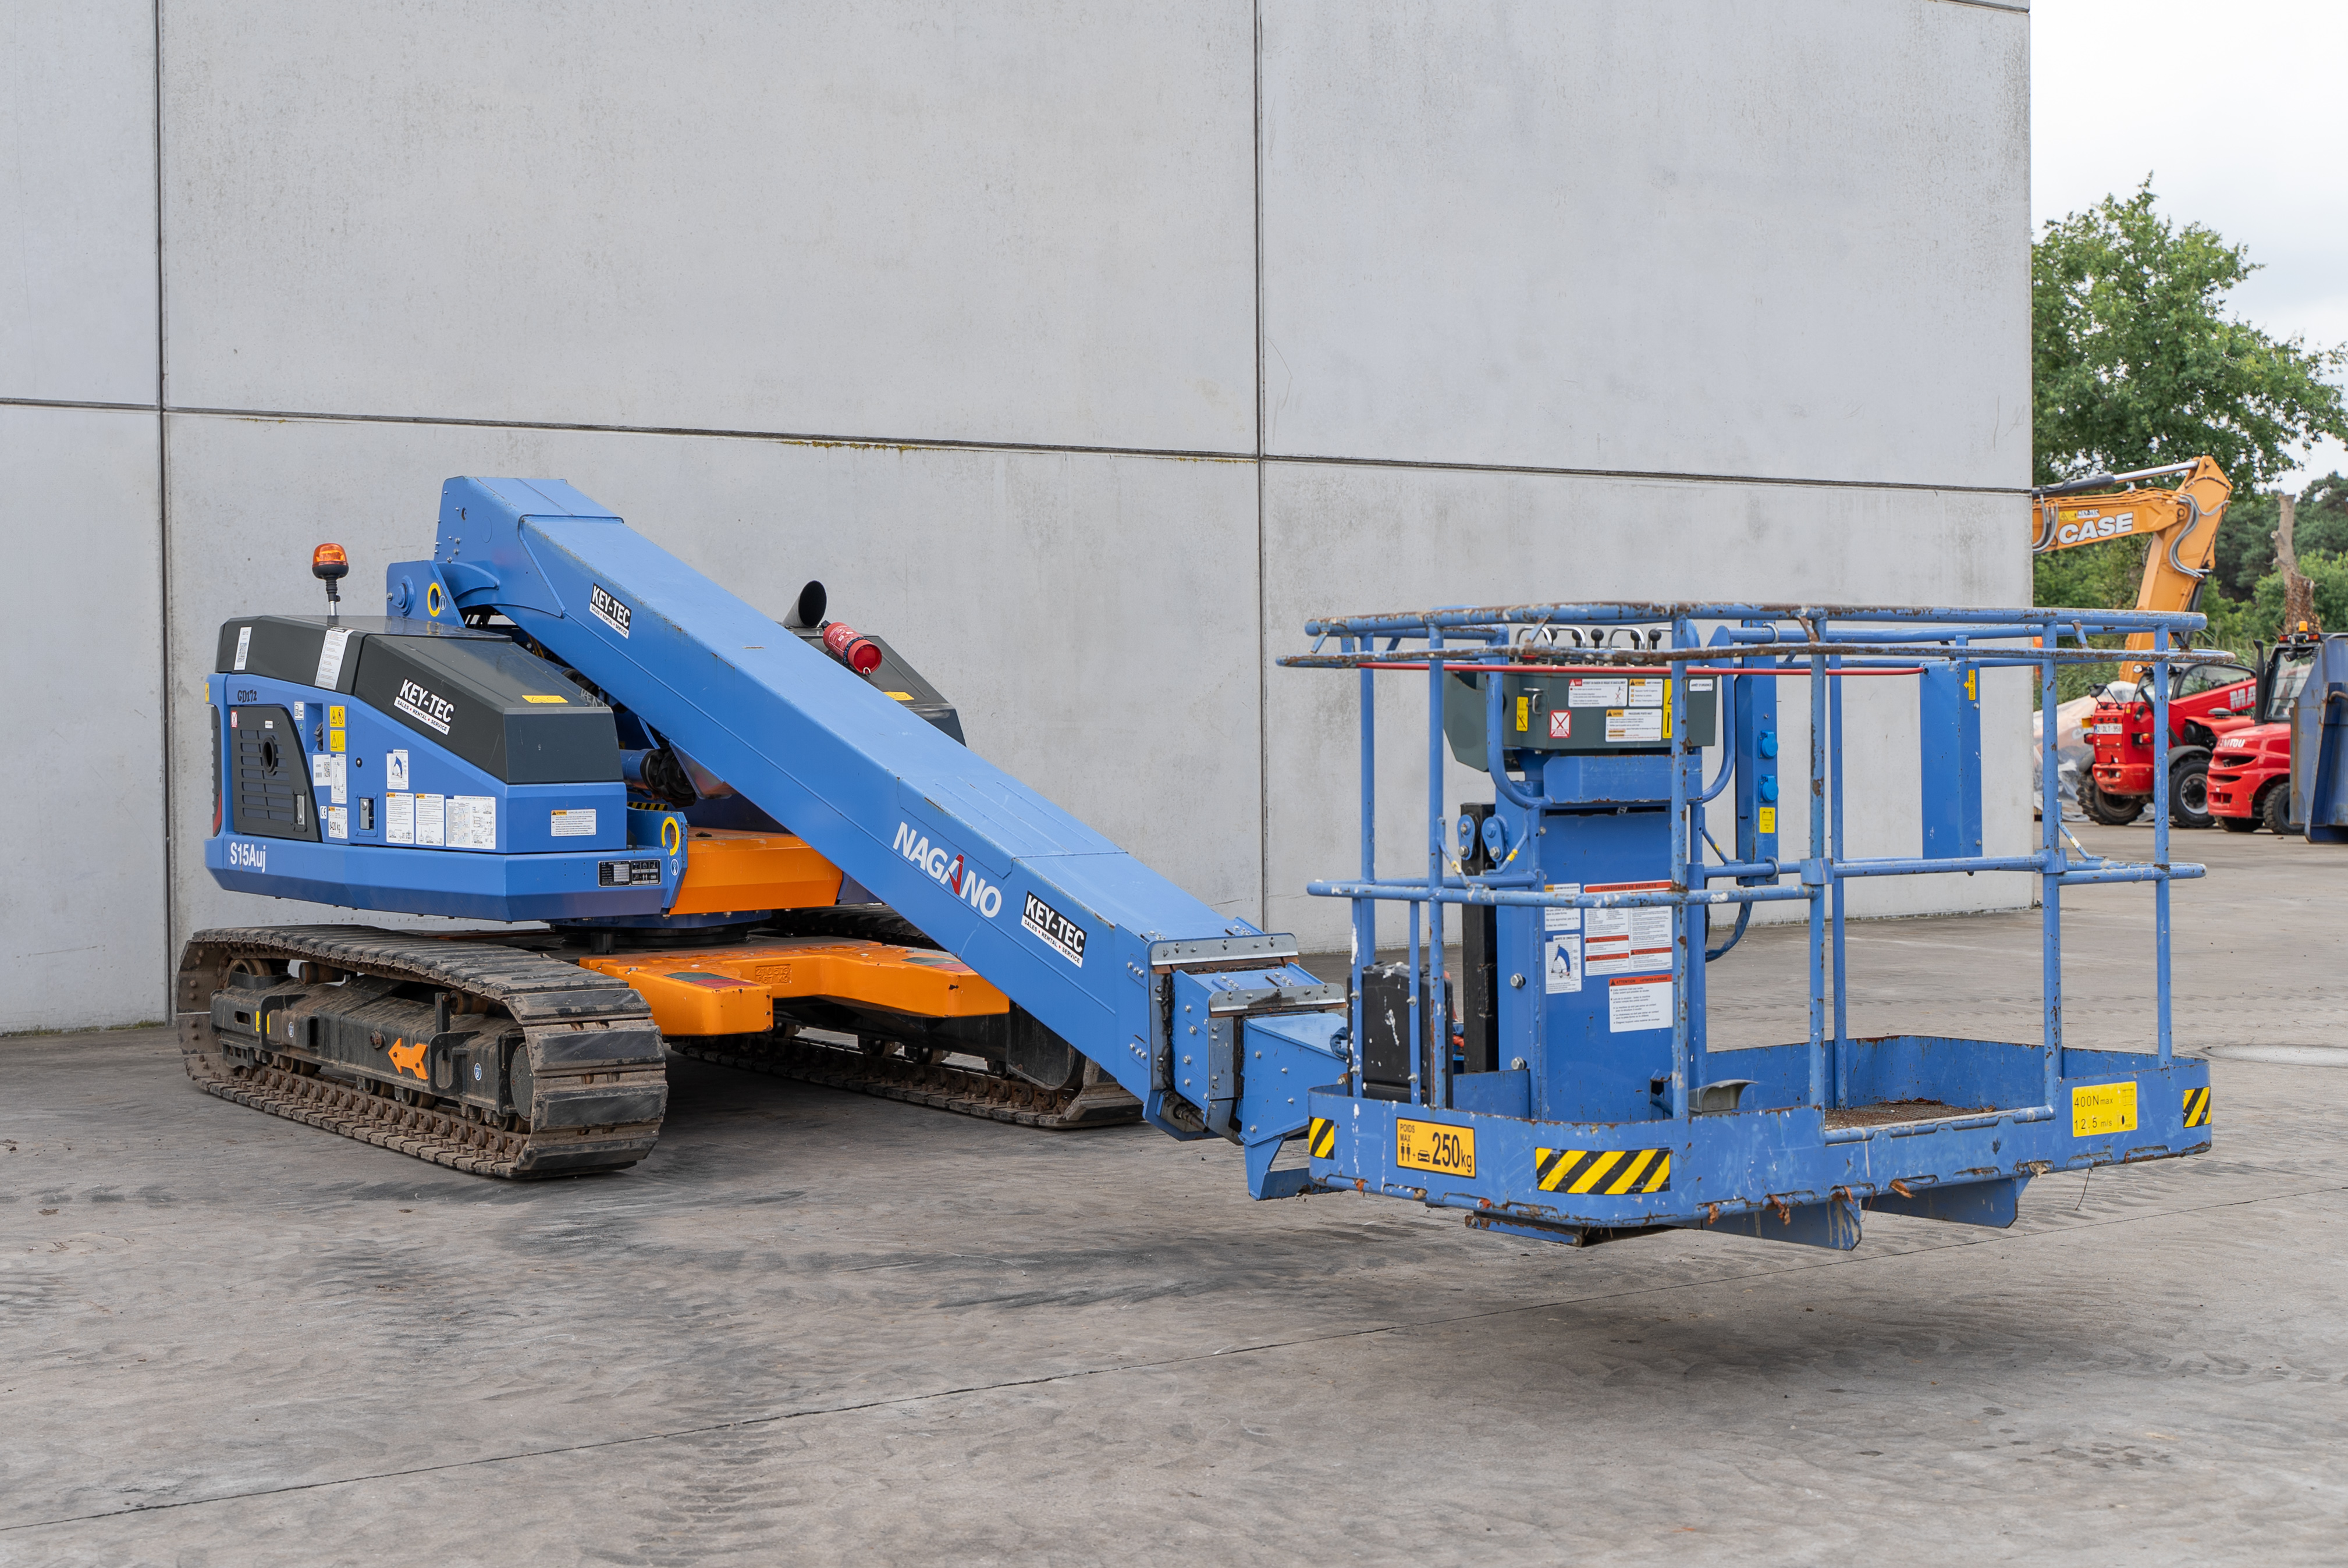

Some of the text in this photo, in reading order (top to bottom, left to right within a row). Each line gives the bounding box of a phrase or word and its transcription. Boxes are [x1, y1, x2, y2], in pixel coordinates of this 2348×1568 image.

[2058, 511, 2134, 545] CASE
[592, 585, 630, 627] KEY-TEC
[397, 700, 447, 732] SALES RENTAL SERVICE
[399, 678, 454, 723] KEY-TEC
[230, 842, 266, 873] S15Auj
[893, 822, 1002, 918] NAGANO
[1025, 894, 1084, 952] KEY-TEC
[1024, 919, 1080, 963] SALES RENTAL SERVICE
[1400, 1123, 1415, 1133] POIDS
[1400, 1133, 1411, 1143] MAX
[2101, 1119, 2112, 1127] m/s
